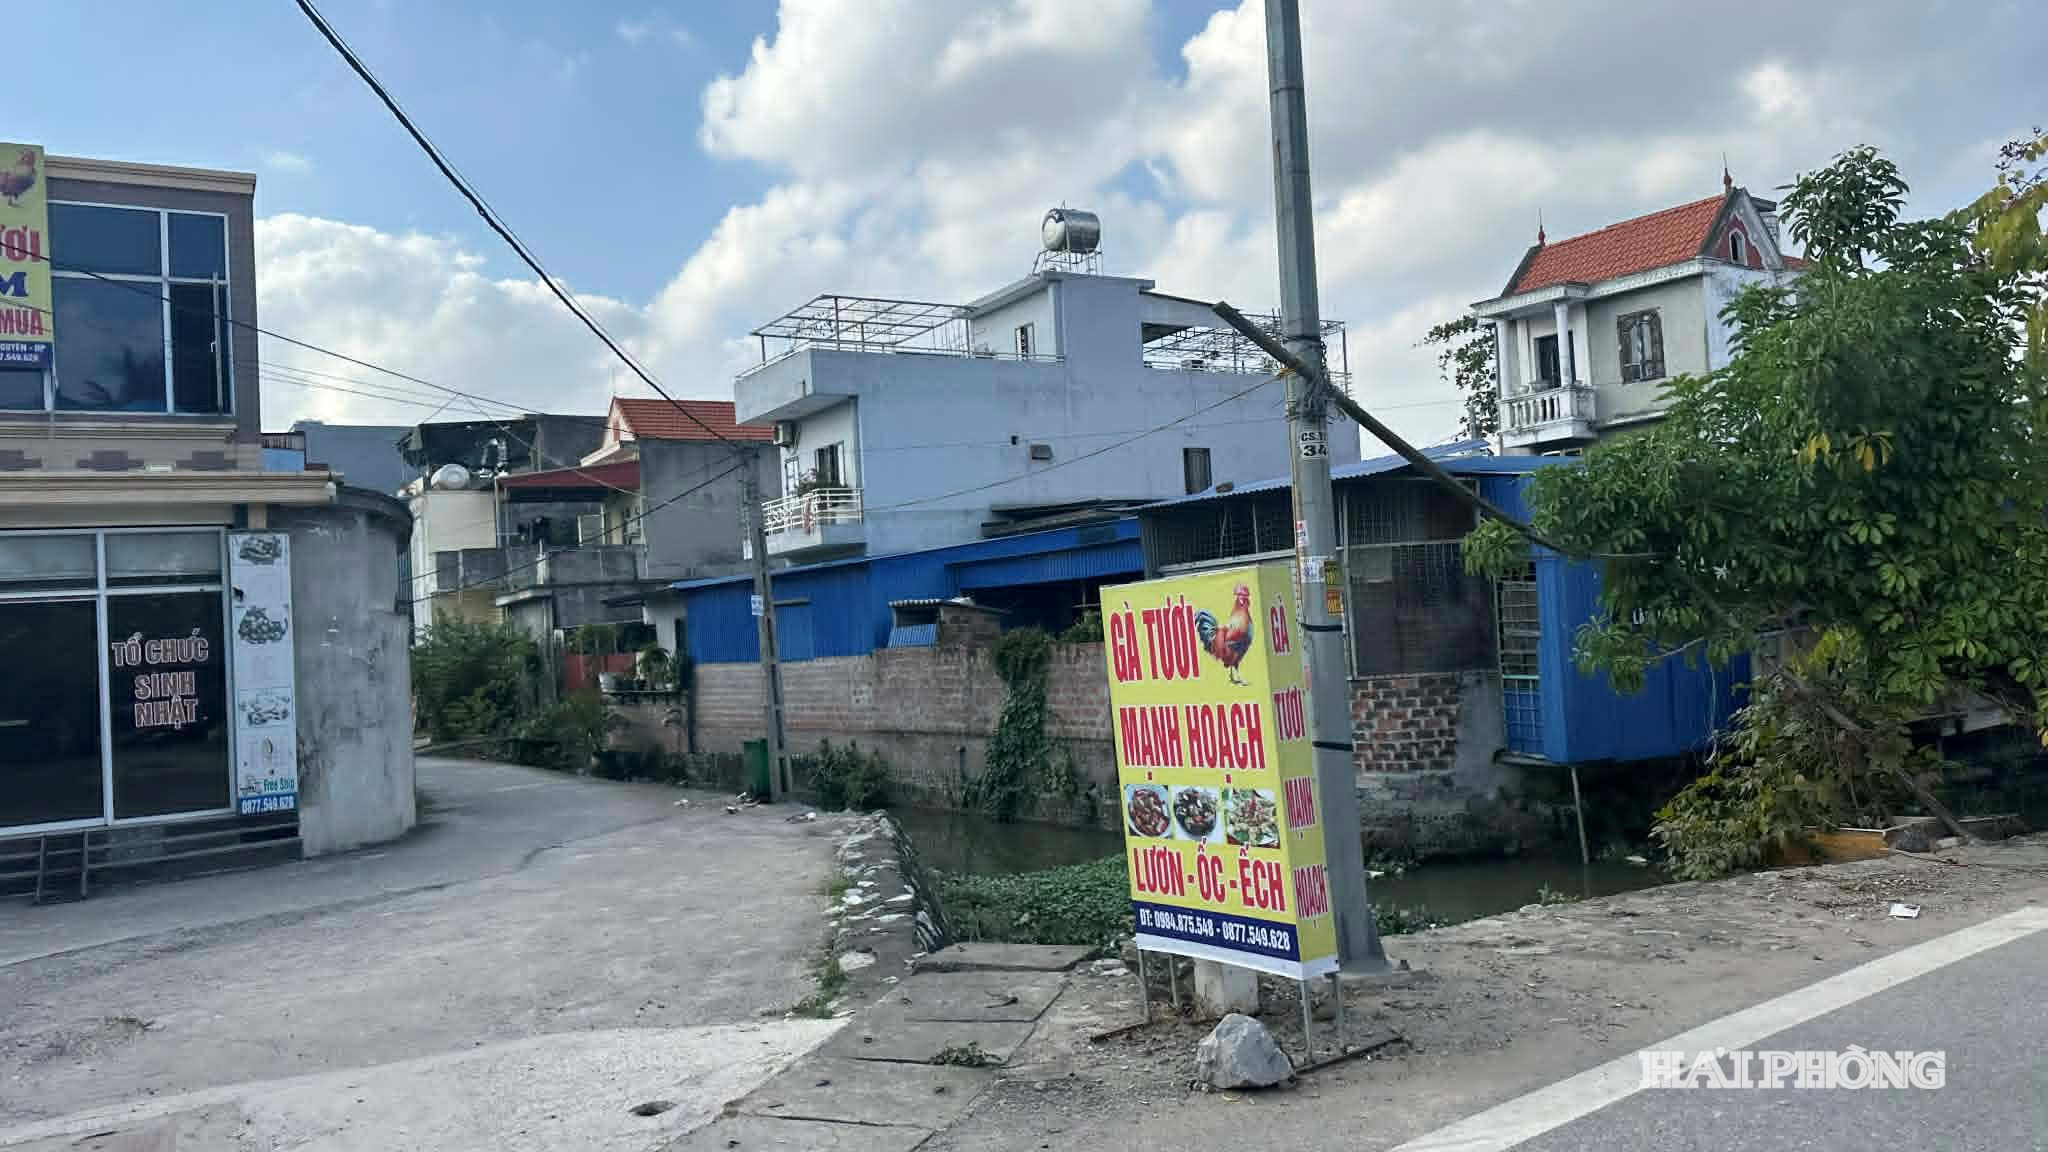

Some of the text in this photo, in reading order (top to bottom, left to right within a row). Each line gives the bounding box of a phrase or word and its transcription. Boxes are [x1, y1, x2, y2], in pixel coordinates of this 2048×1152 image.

[145, 627, 209, 665] CHỨC
[1110, 594, 1200, 683] GÀ TƯƠI
[1270, 594, 1291, 654] GÀ
[134, 671, 195, 700] SINH
[134, 694, 199, 729] NHẬT
[1274, 686, 1306, 740] TƯƠI
[1120, 703, 1266, 785] MẠNH HOẠCH
[1284, 776, 1316, 840] MẠNH
[1133, 846, 1185, 897] LƯƠN
[1197, 836, 1226, 903] ỐC
[1238, 843, 1286, 913] ẾCH
[1293, 864, 1329, 929] HOẠCH
[1154, 913, 1215, 938] 0984.875.548
[1221, 921, 1291, 952] 0877.549.628
